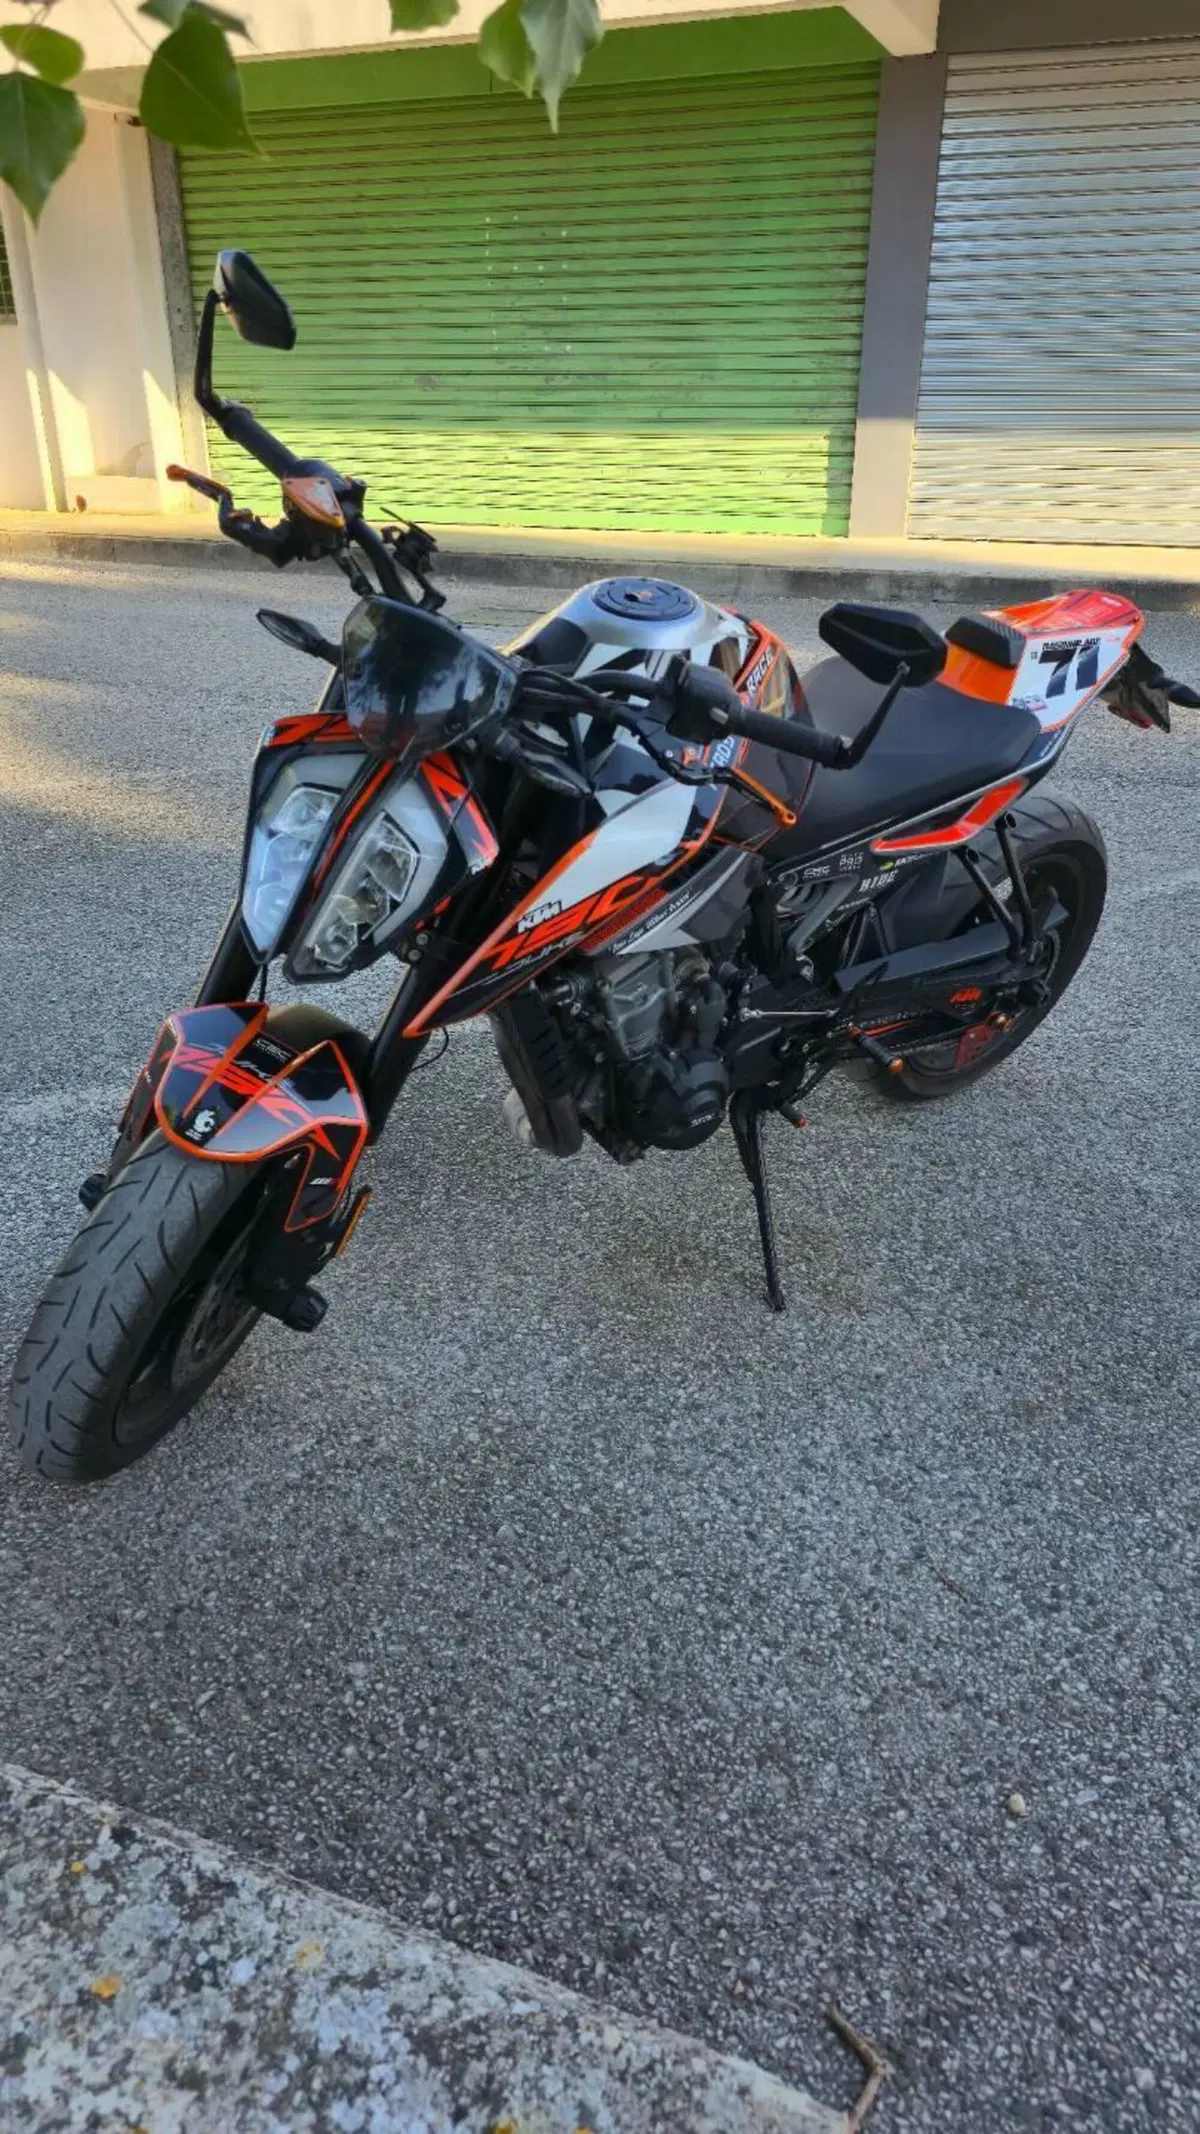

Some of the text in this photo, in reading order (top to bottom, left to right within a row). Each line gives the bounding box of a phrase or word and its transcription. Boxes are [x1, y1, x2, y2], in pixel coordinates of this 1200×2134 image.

[1038, 646, 1100, 698] 71
[517, 900, 563, 934] KTM
[949, 985, 984, 1003] KTM
